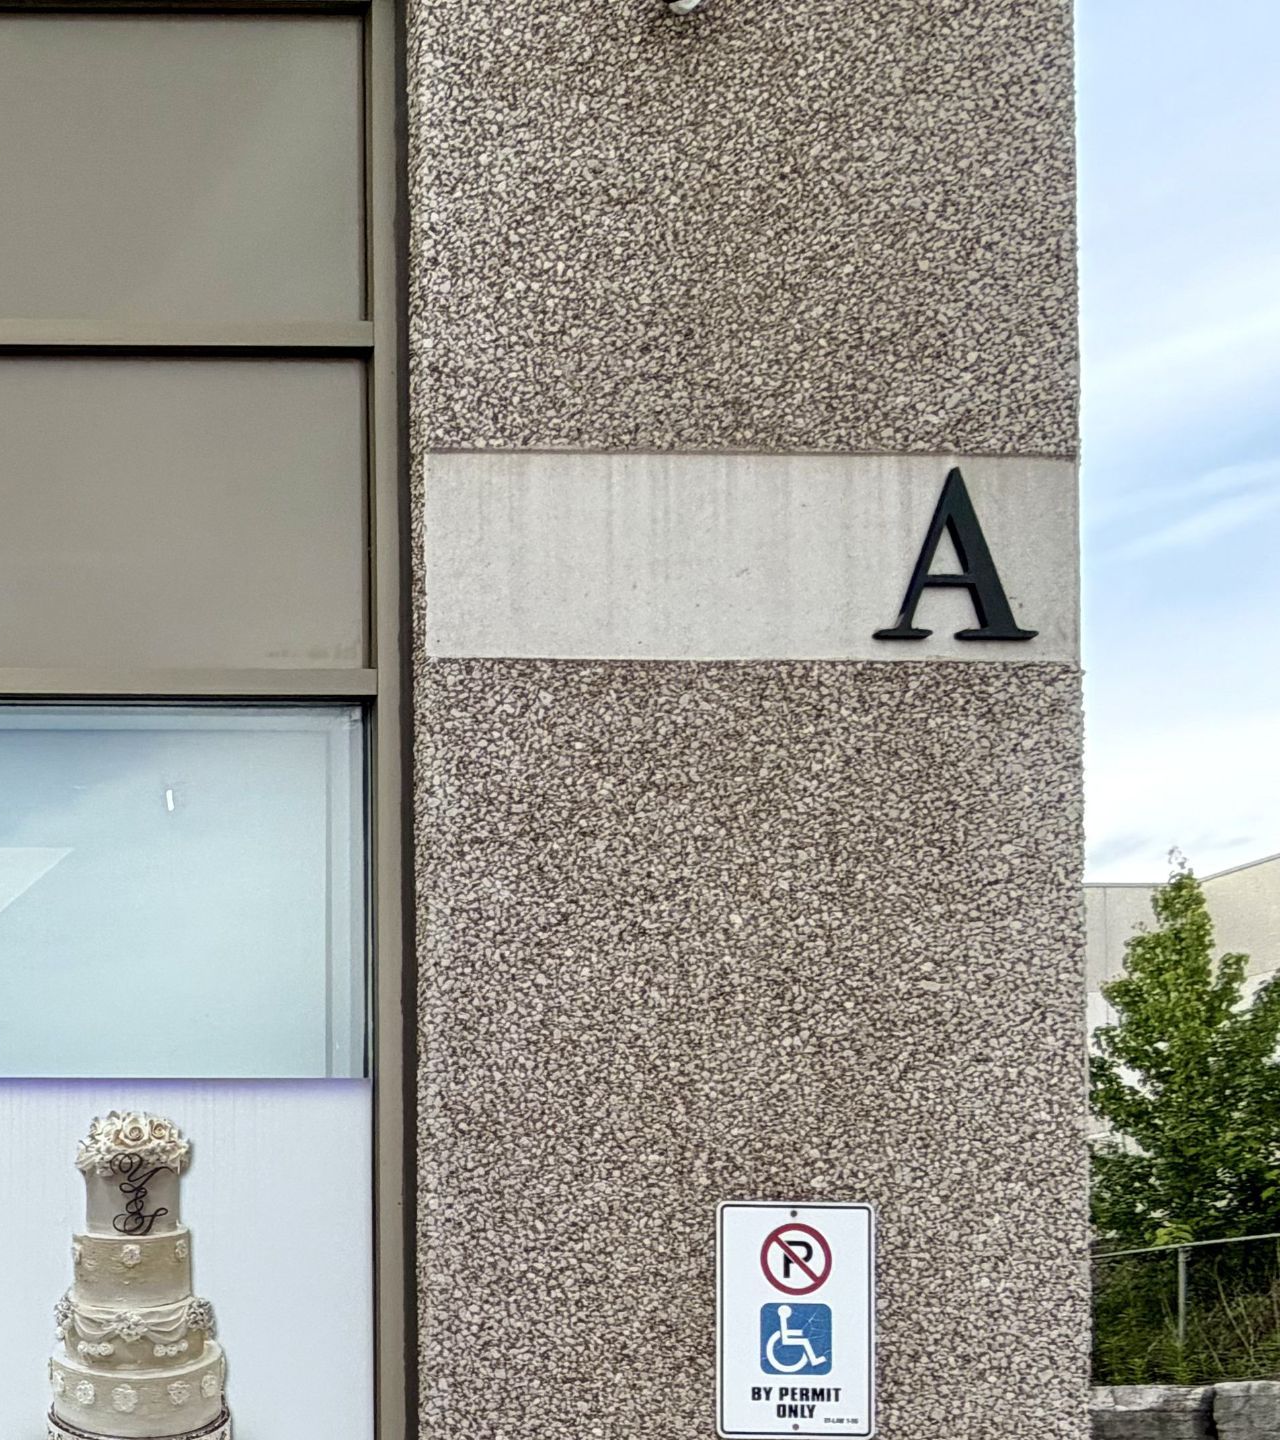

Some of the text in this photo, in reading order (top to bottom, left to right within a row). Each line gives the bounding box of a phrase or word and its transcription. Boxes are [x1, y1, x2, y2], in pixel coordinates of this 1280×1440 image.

[872, 466, 1039, 640] A
[751, 1386, 842, 1402] BY PERMIT
[776, 1404, 816, 1419] ONLY
